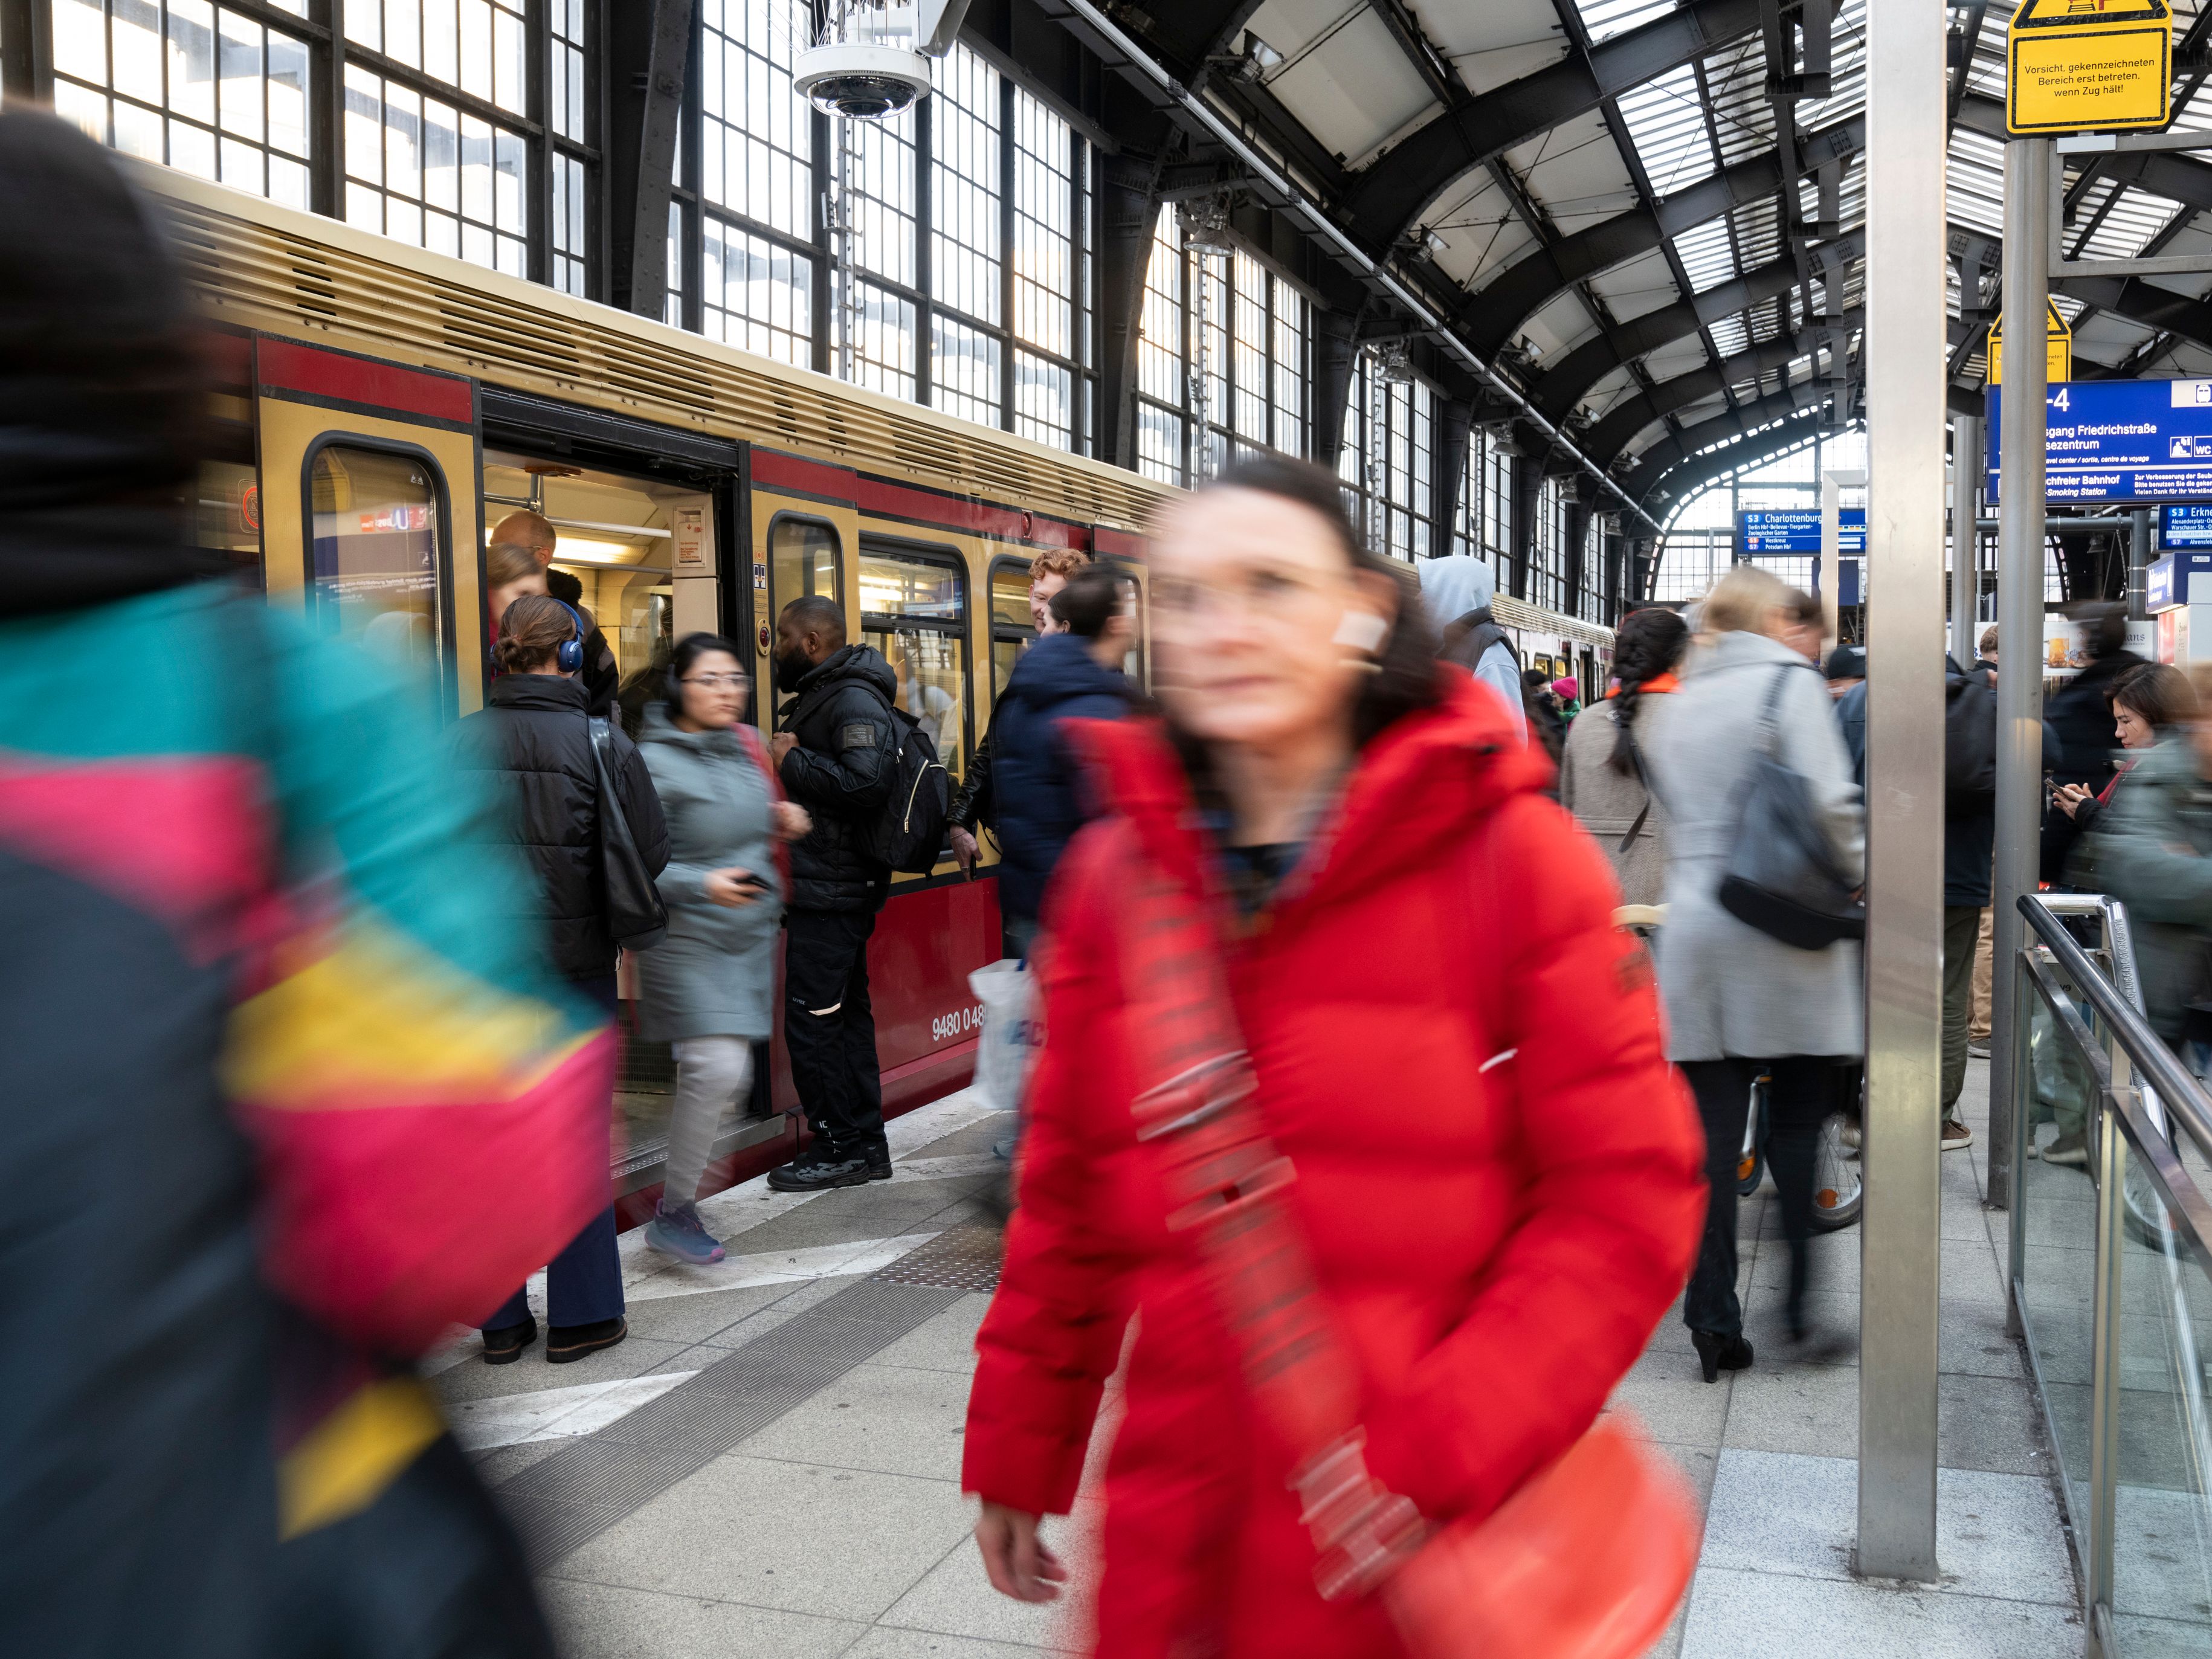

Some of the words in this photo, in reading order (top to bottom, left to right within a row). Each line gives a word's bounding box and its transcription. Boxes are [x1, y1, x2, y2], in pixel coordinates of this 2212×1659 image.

[2025, 64, 2066, 74] Vorsicht,
[2068, 59, 2155, 73] gekennzeichneten
[2039, 75, 2074, 86] Bereich
[2077, 74, 2095, 83] erst
[2098, 72, 2140, 82] betreten,
[2054, 89, 2080, 97] wenn
[2083, 87, 2100, 96] Zug
[2103, 85, 2124, 94] hält!
[2077, 423, 2157, 436] Friedrichstraße
[2196, 445, 2211, 455] WC
[2045, 475, 2080, 486] chfreier
[2082, 474, 2120, 485] Bahnhof
[2080, 488, 2107, 496] Station
[1765, 513, 1822, 524] Charlottenburg
[932, 1011, 961, 1042] 9480
